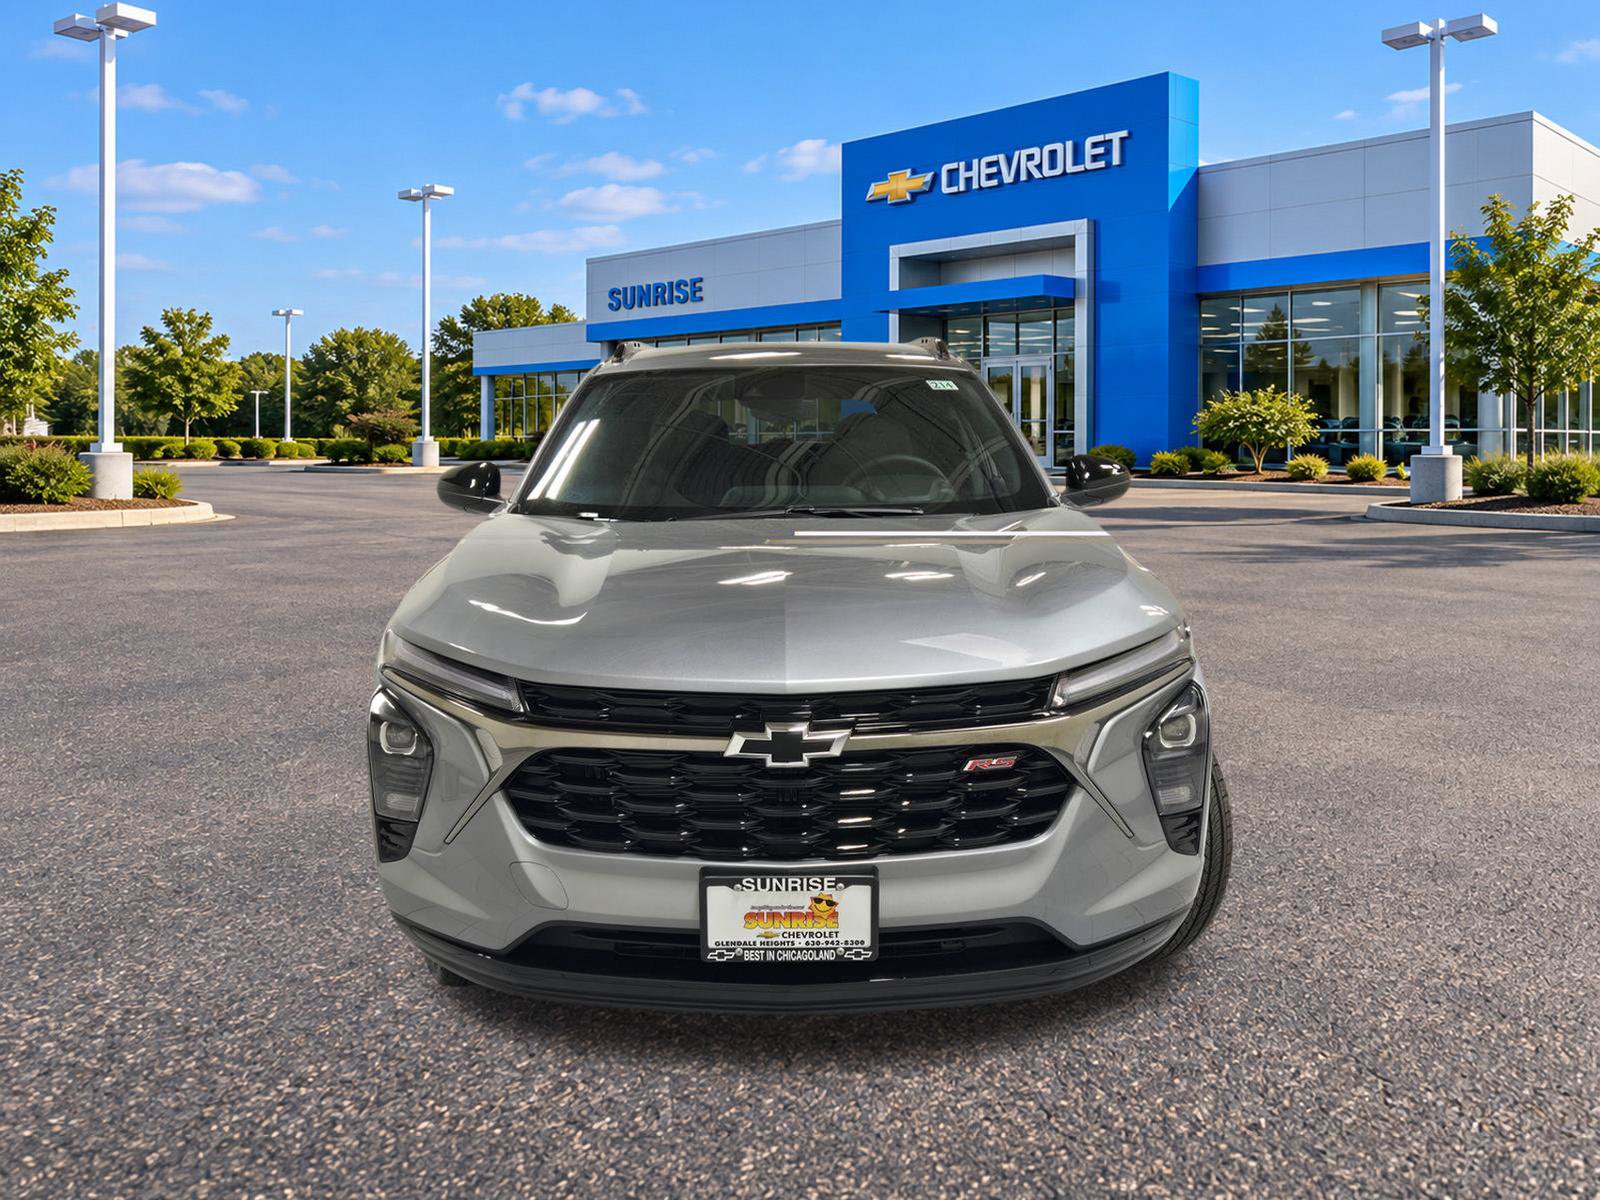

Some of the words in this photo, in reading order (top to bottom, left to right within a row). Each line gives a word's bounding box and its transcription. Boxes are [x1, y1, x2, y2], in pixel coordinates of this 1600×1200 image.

[940, 130, 1129, 194] CHEVROLET
[608, 277, 704, 312] SUNRISE
[963, 755, 1017, 772] RS
[742, 878, 836, 892] SUNRISE
[743, 911, 839, 929] SUNRISE
[781, 931, 839, 939] CHEVROLET
[744, 950, 765, 961] BEST
[767, 950, 775, 961] IN
[778, 950, 836, 961] CHICAGOLAND
